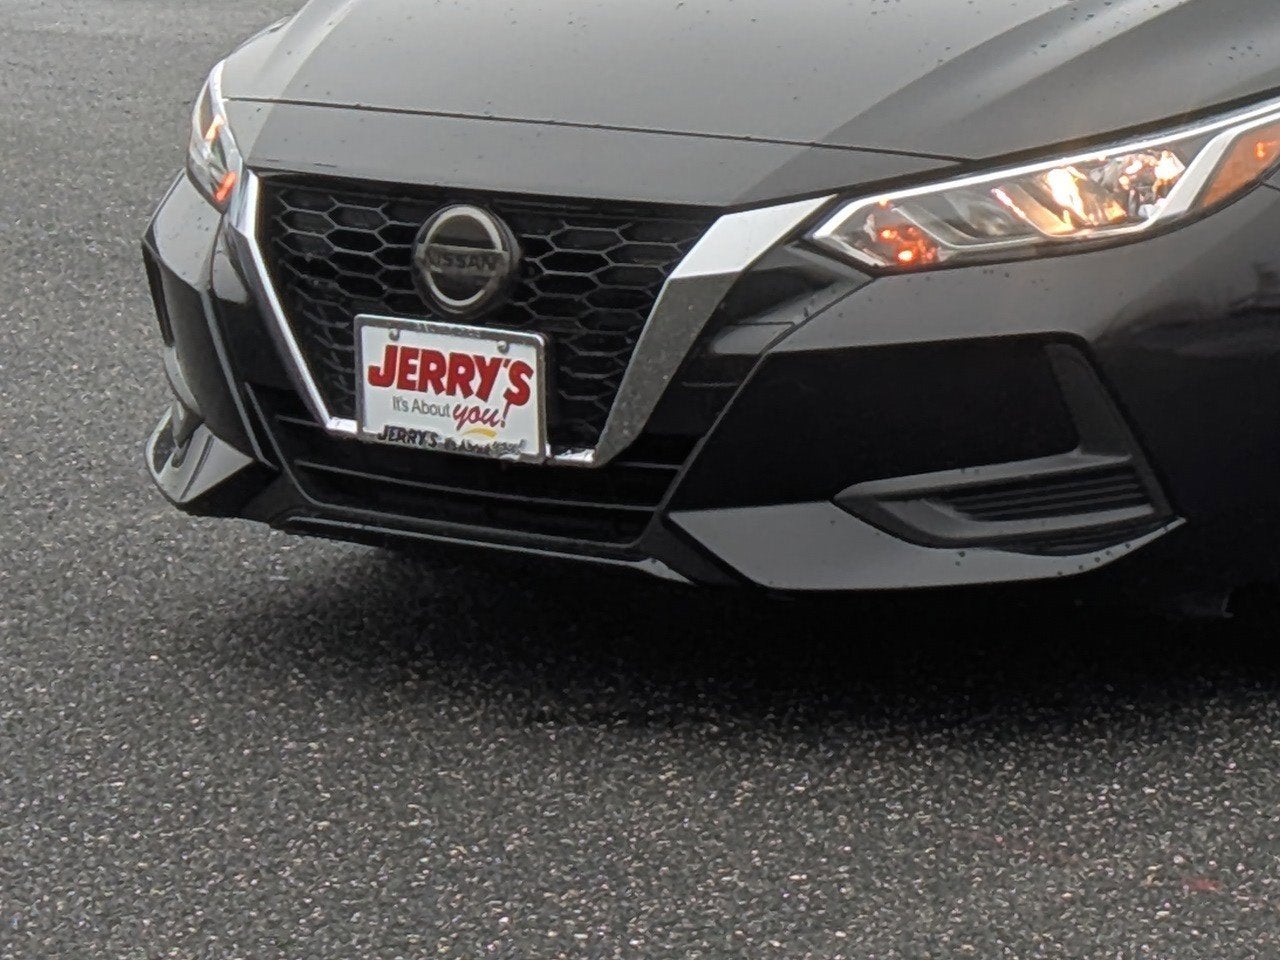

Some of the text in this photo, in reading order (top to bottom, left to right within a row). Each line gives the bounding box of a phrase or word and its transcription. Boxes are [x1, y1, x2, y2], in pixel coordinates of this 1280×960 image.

[368, 344, 535, 407] JERRY'S
[392, 395, 511, 432] It's About you!
